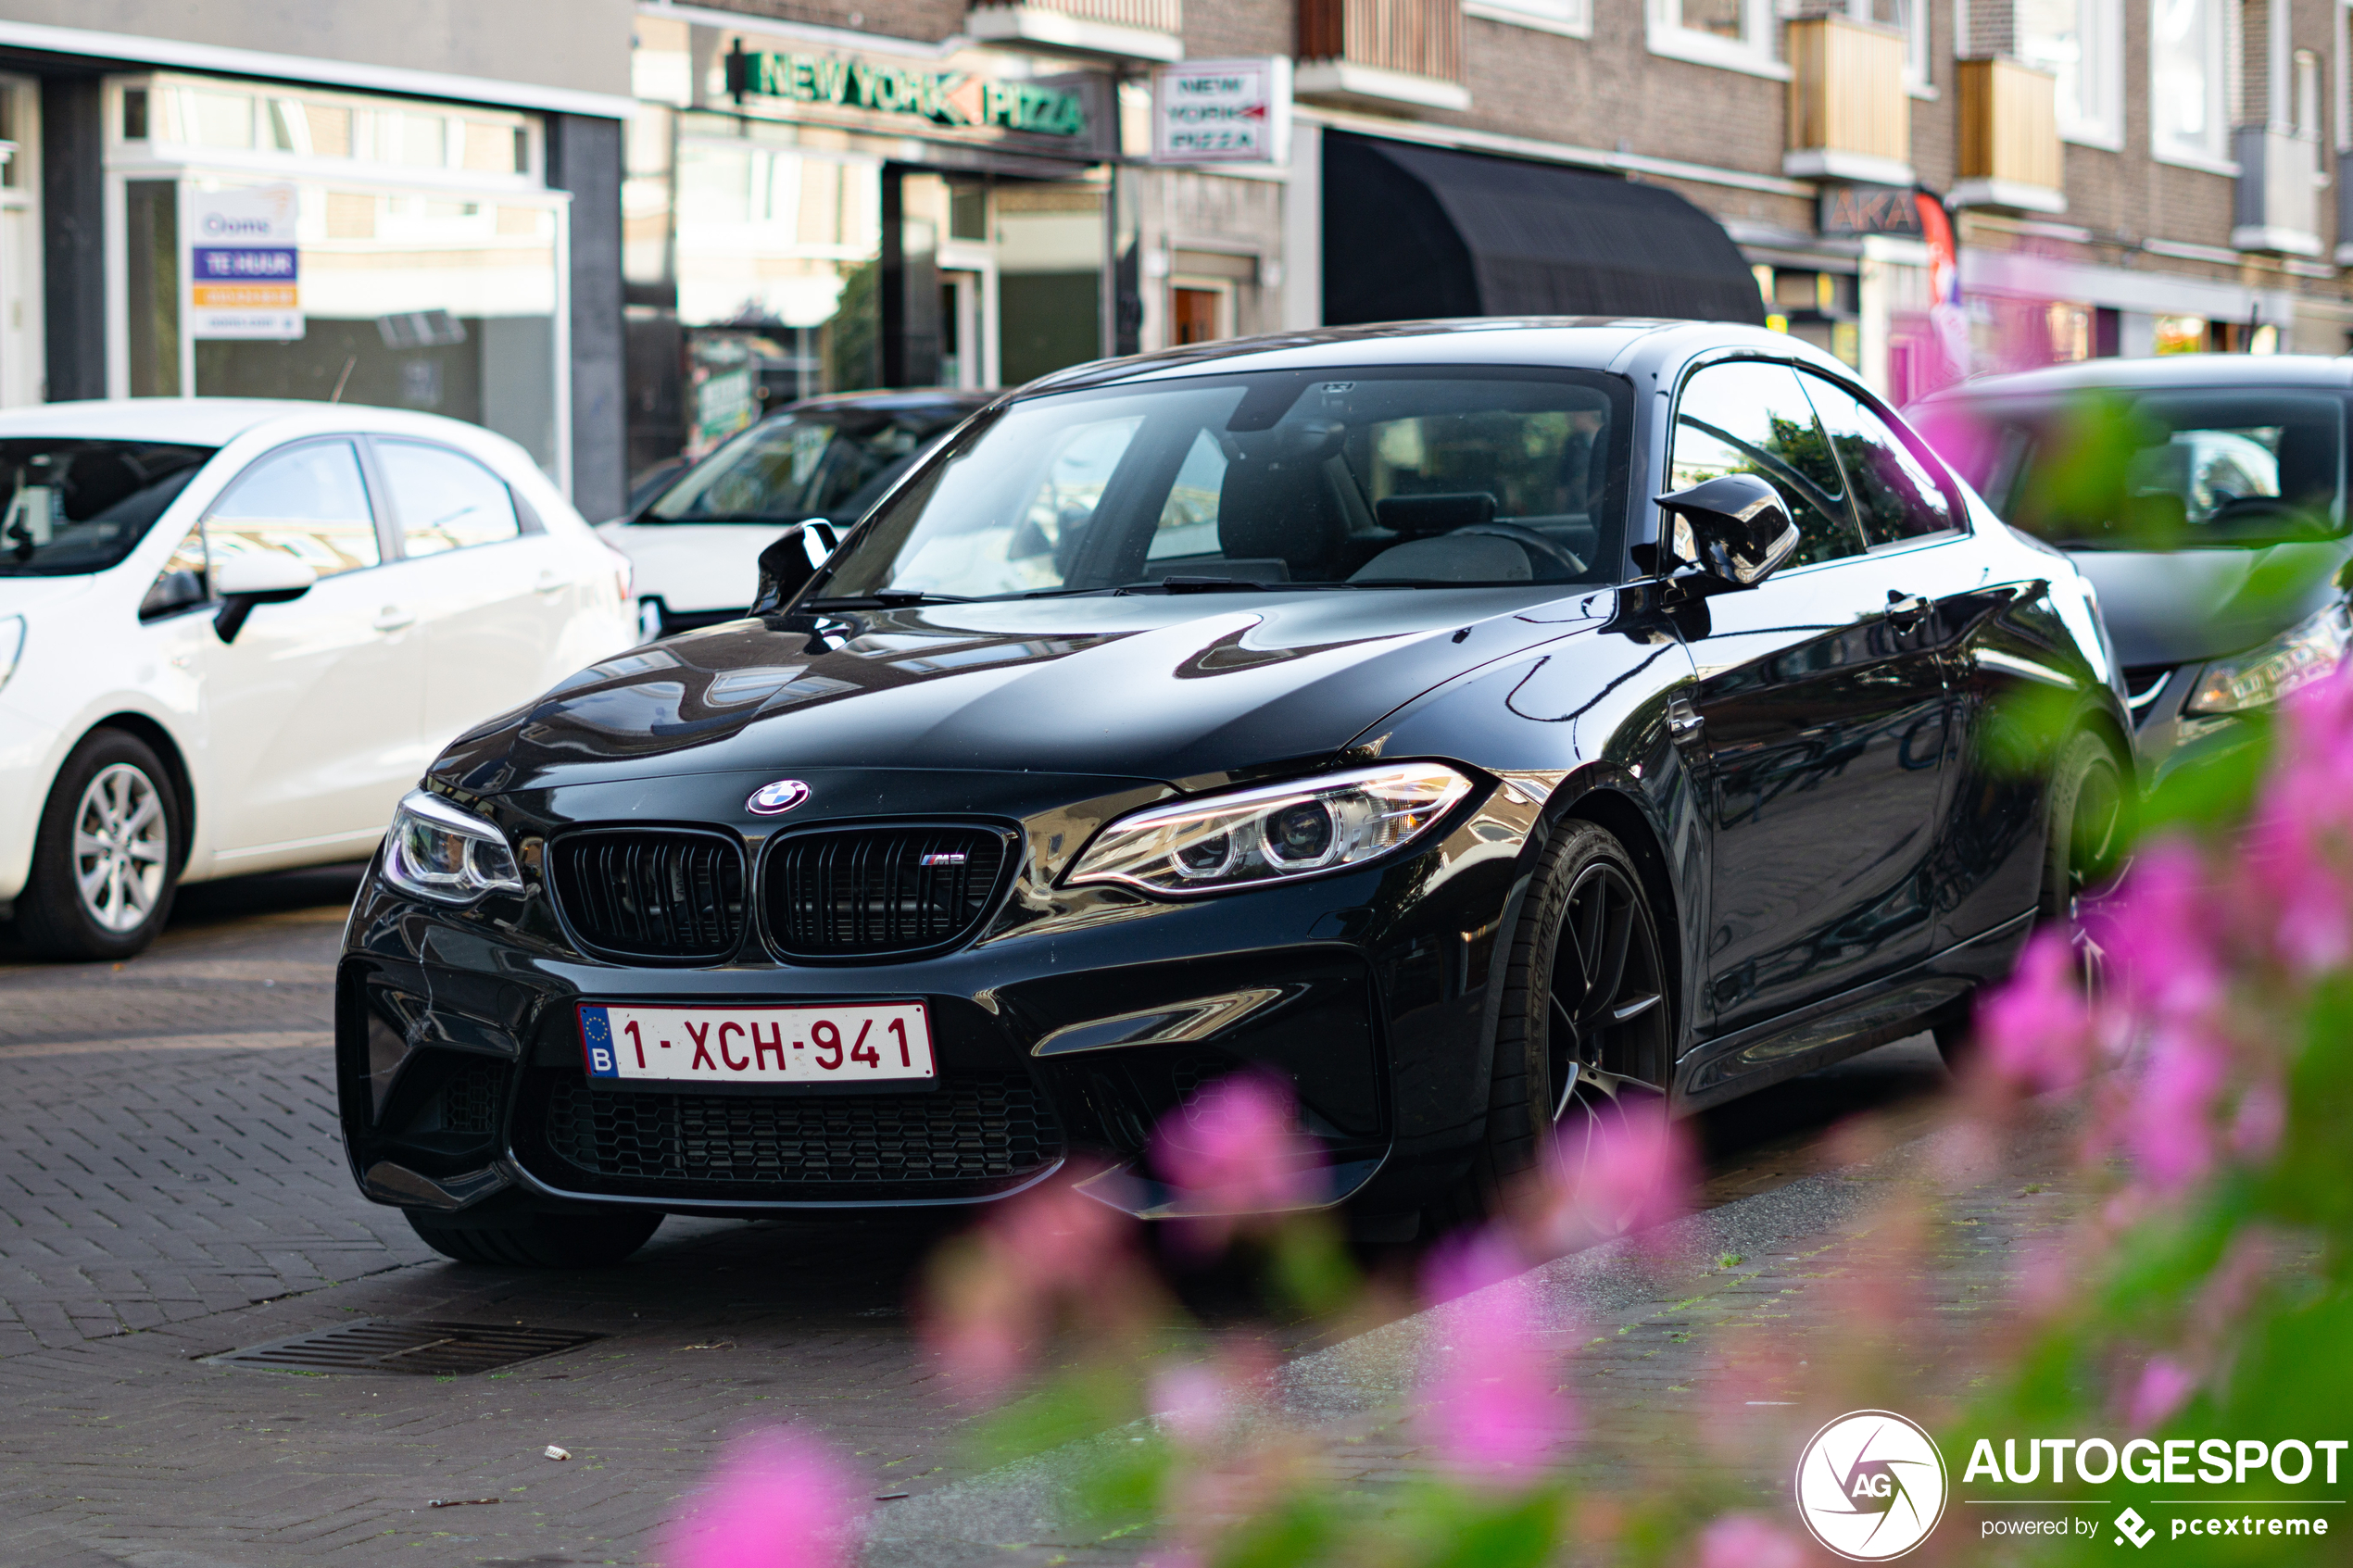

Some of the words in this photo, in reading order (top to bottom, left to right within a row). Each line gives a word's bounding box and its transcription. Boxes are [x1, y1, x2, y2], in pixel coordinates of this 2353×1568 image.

[760, 51, 848, 105] NEW
[852, 61, 971, 128] YORK
[983, 81, 1085, 136] PIZZA
[1178, 78, 1243, 94] NEW
[1169, 104, 1251, 124] YORK
[1170, 132, 1254, 149] PIZZA
[1828, 188, 1920, 232] AKA
[205, 251, 232, 275] TE
[233, 251, 293, 275] HUUR
[931, 854, 965, 865] M2
[1531, 906, 1555, 1022] MICHELIN
[623, 1017, 912, 1072] 1-XCH-941
[591, 1047, 613, 1073] B
